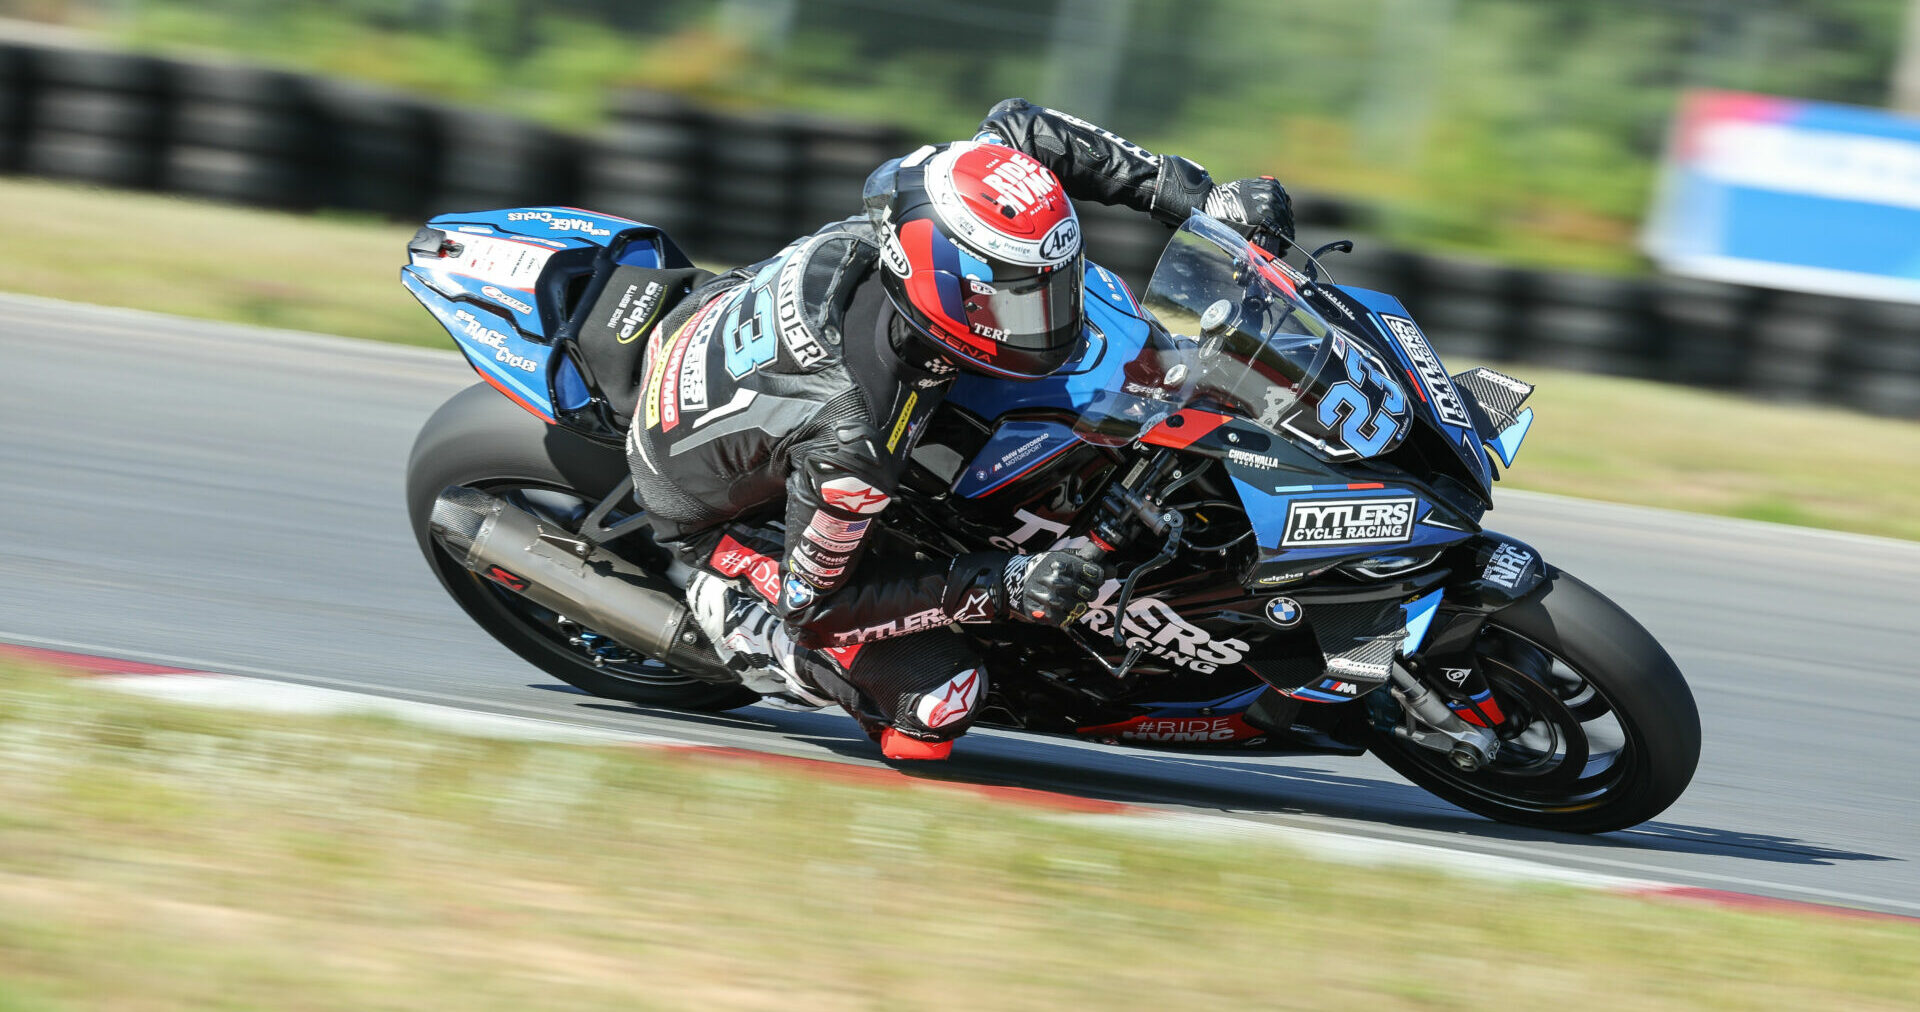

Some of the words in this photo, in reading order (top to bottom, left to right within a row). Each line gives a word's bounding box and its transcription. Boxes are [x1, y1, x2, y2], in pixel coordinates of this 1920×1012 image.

[982, 153, 1038, 193] RIDE
[549, 218, 594, 233] RAGE
[1044, 223, 1078, 258] Arai
[881, 220, 904, 270] Arai
[1003, 242, 1031, 255] Prestige
[620, 281, 660, 339] alpha
[464, 320, 508, 350] RAGE
[928, 324, 991, 363] SENA
[1404, 325, 1442, 375] RACING
[1390, 320, 1453, 419] TYTLERS
[1316, 341, 1407, 459] 23
[1001, 450, 1018, 463] BMW
[1017, 433, 1049, 453] MOTORRAD
[1005, 443, 1042, 467] MOTORSPORT
[1228, 449, 1279, 468] CHUCKWALLA
[1233, 459, 1271, 470] RACEWAY
[1295, 504, 1409, 529] TYTLERS
[1293, 527, 1343, 540] CYCLE
[1345, 525, 1402, 538] RACING
[1262, 573, 1304, 582] alpha
[1489, 545, 1531, 588] NRC
[1137, 718, 1229, 733] #RIDE
